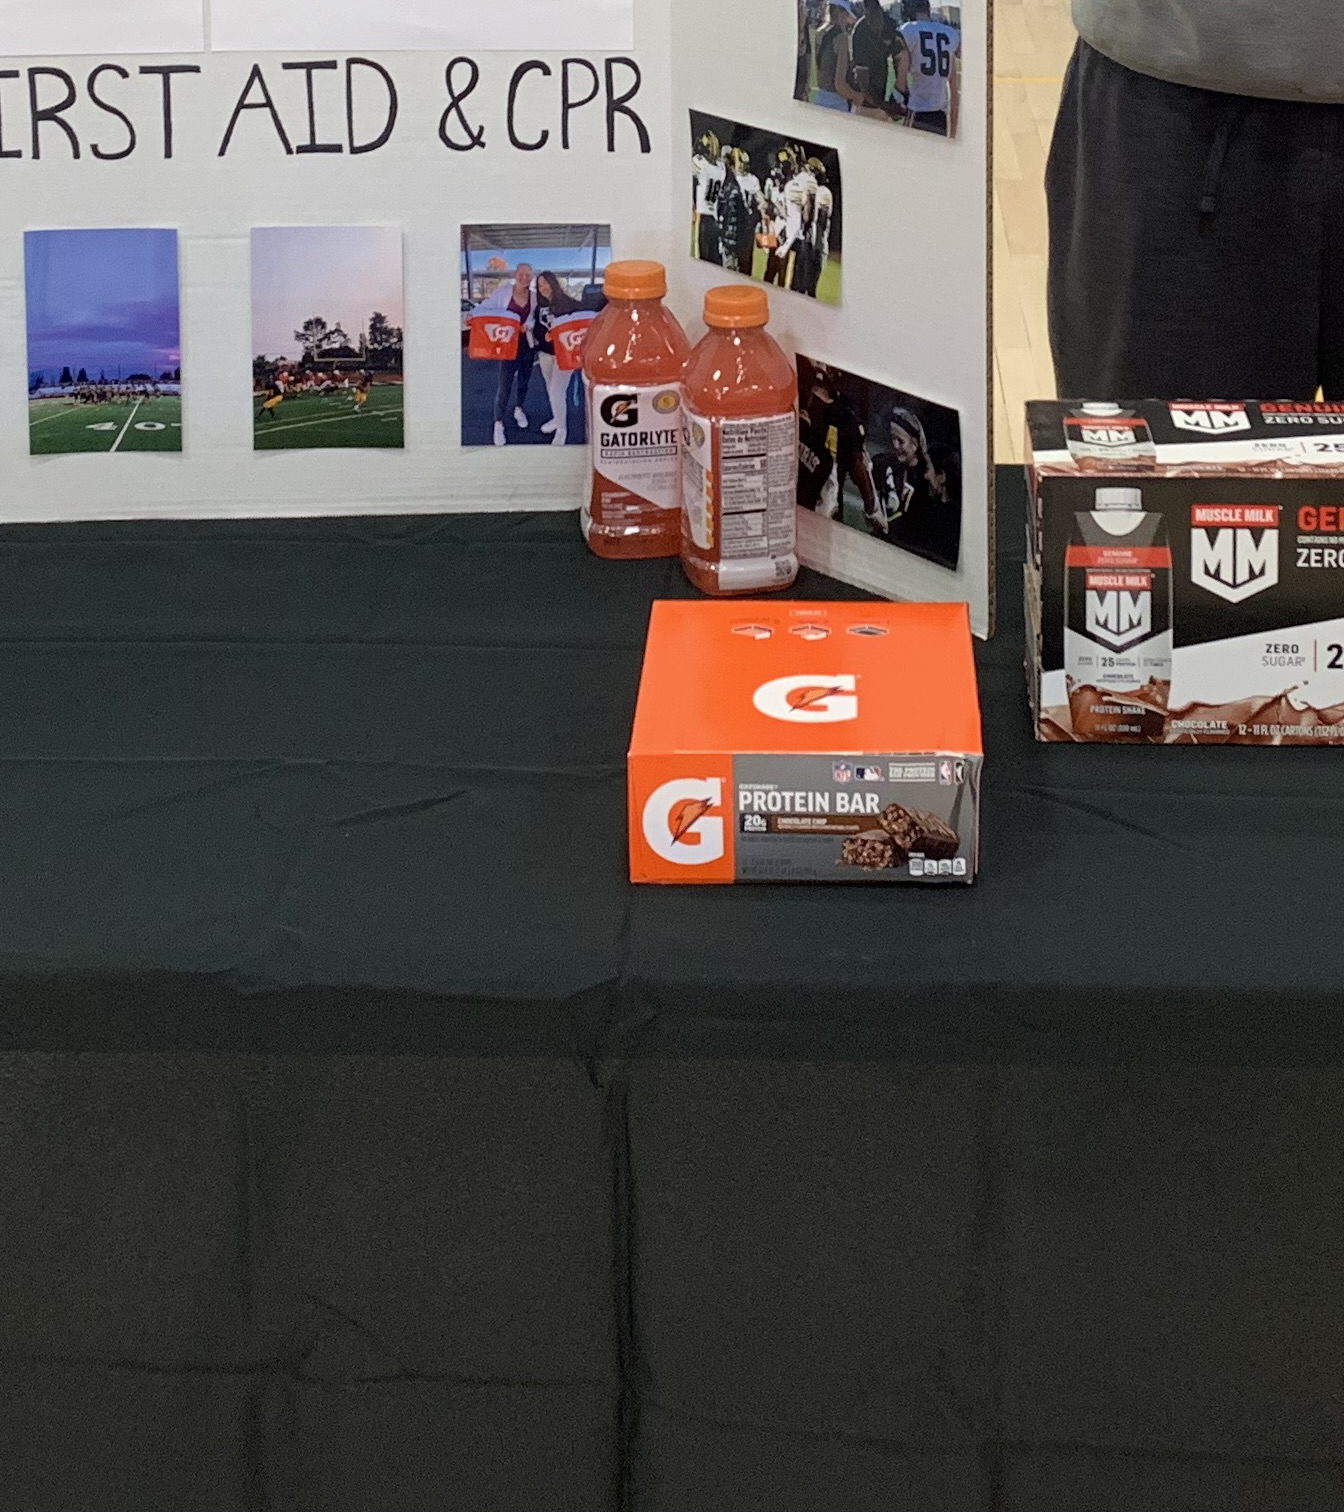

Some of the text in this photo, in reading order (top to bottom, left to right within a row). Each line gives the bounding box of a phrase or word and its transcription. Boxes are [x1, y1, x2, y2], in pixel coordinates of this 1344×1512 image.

[919, 30, 951, 77] 56
[217, 57, 399, 158] AID
[438, 55, 486, 151] &
[506, 56, 652, 155] CPR
[600, 394, 638, 427] G
[600, 429, 678, 447] GATORLYTE
[1196, 508, 1274, 522] MUSCLE MILK
[753, 674, 858, 723] G
[642, 777, 725, 866] G
[739, 791, 880, 814] PROTEIN BAR
